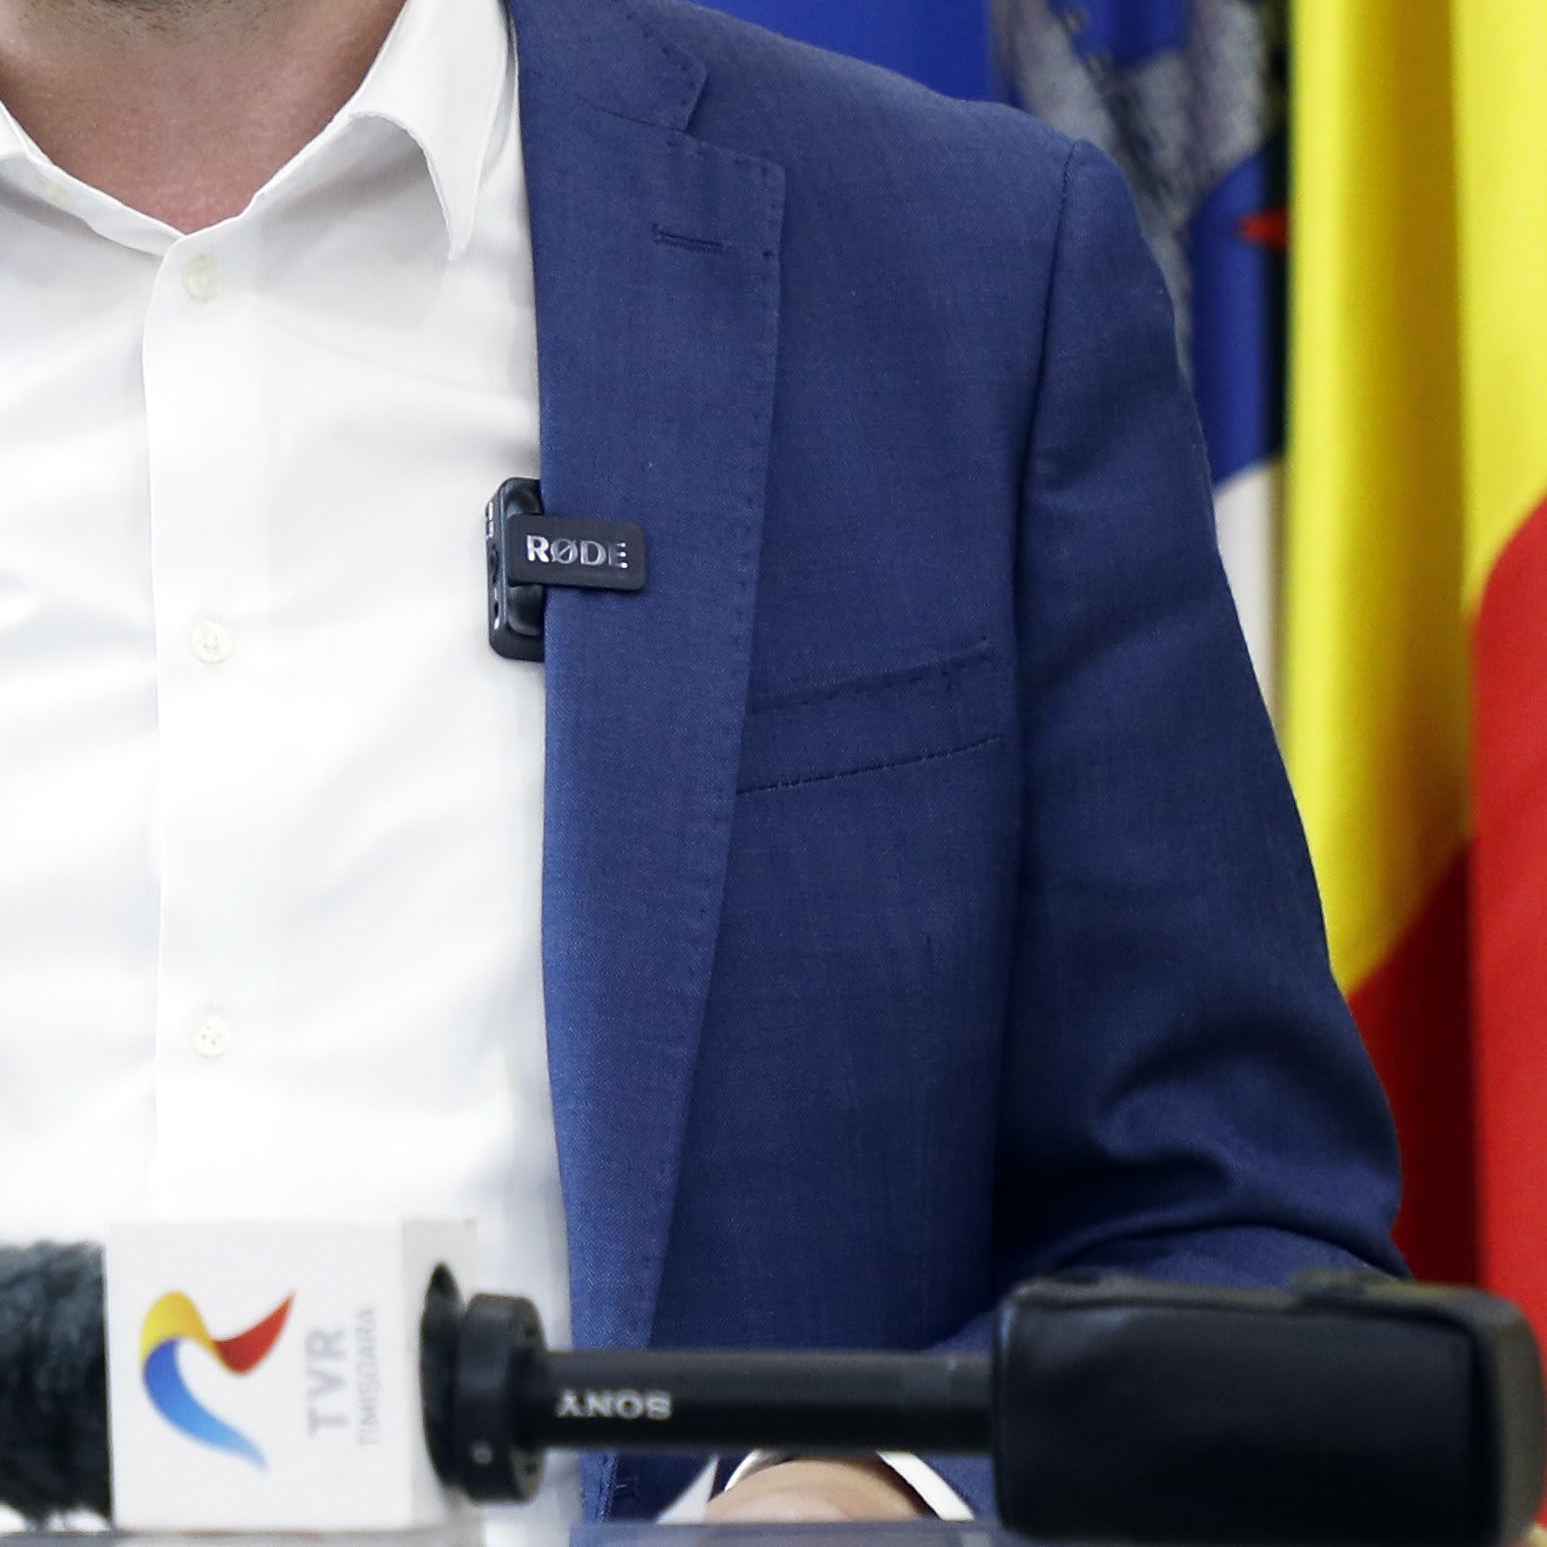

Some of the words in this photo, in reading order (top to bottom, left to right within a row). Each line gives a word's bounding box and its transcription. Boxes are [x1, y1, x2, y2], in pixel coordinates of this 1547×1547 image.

[525, 534, 629, 569] RØDE
[306, 1326, 348, 1436] TVR
[555, 1388, 673, 1420] SONY
